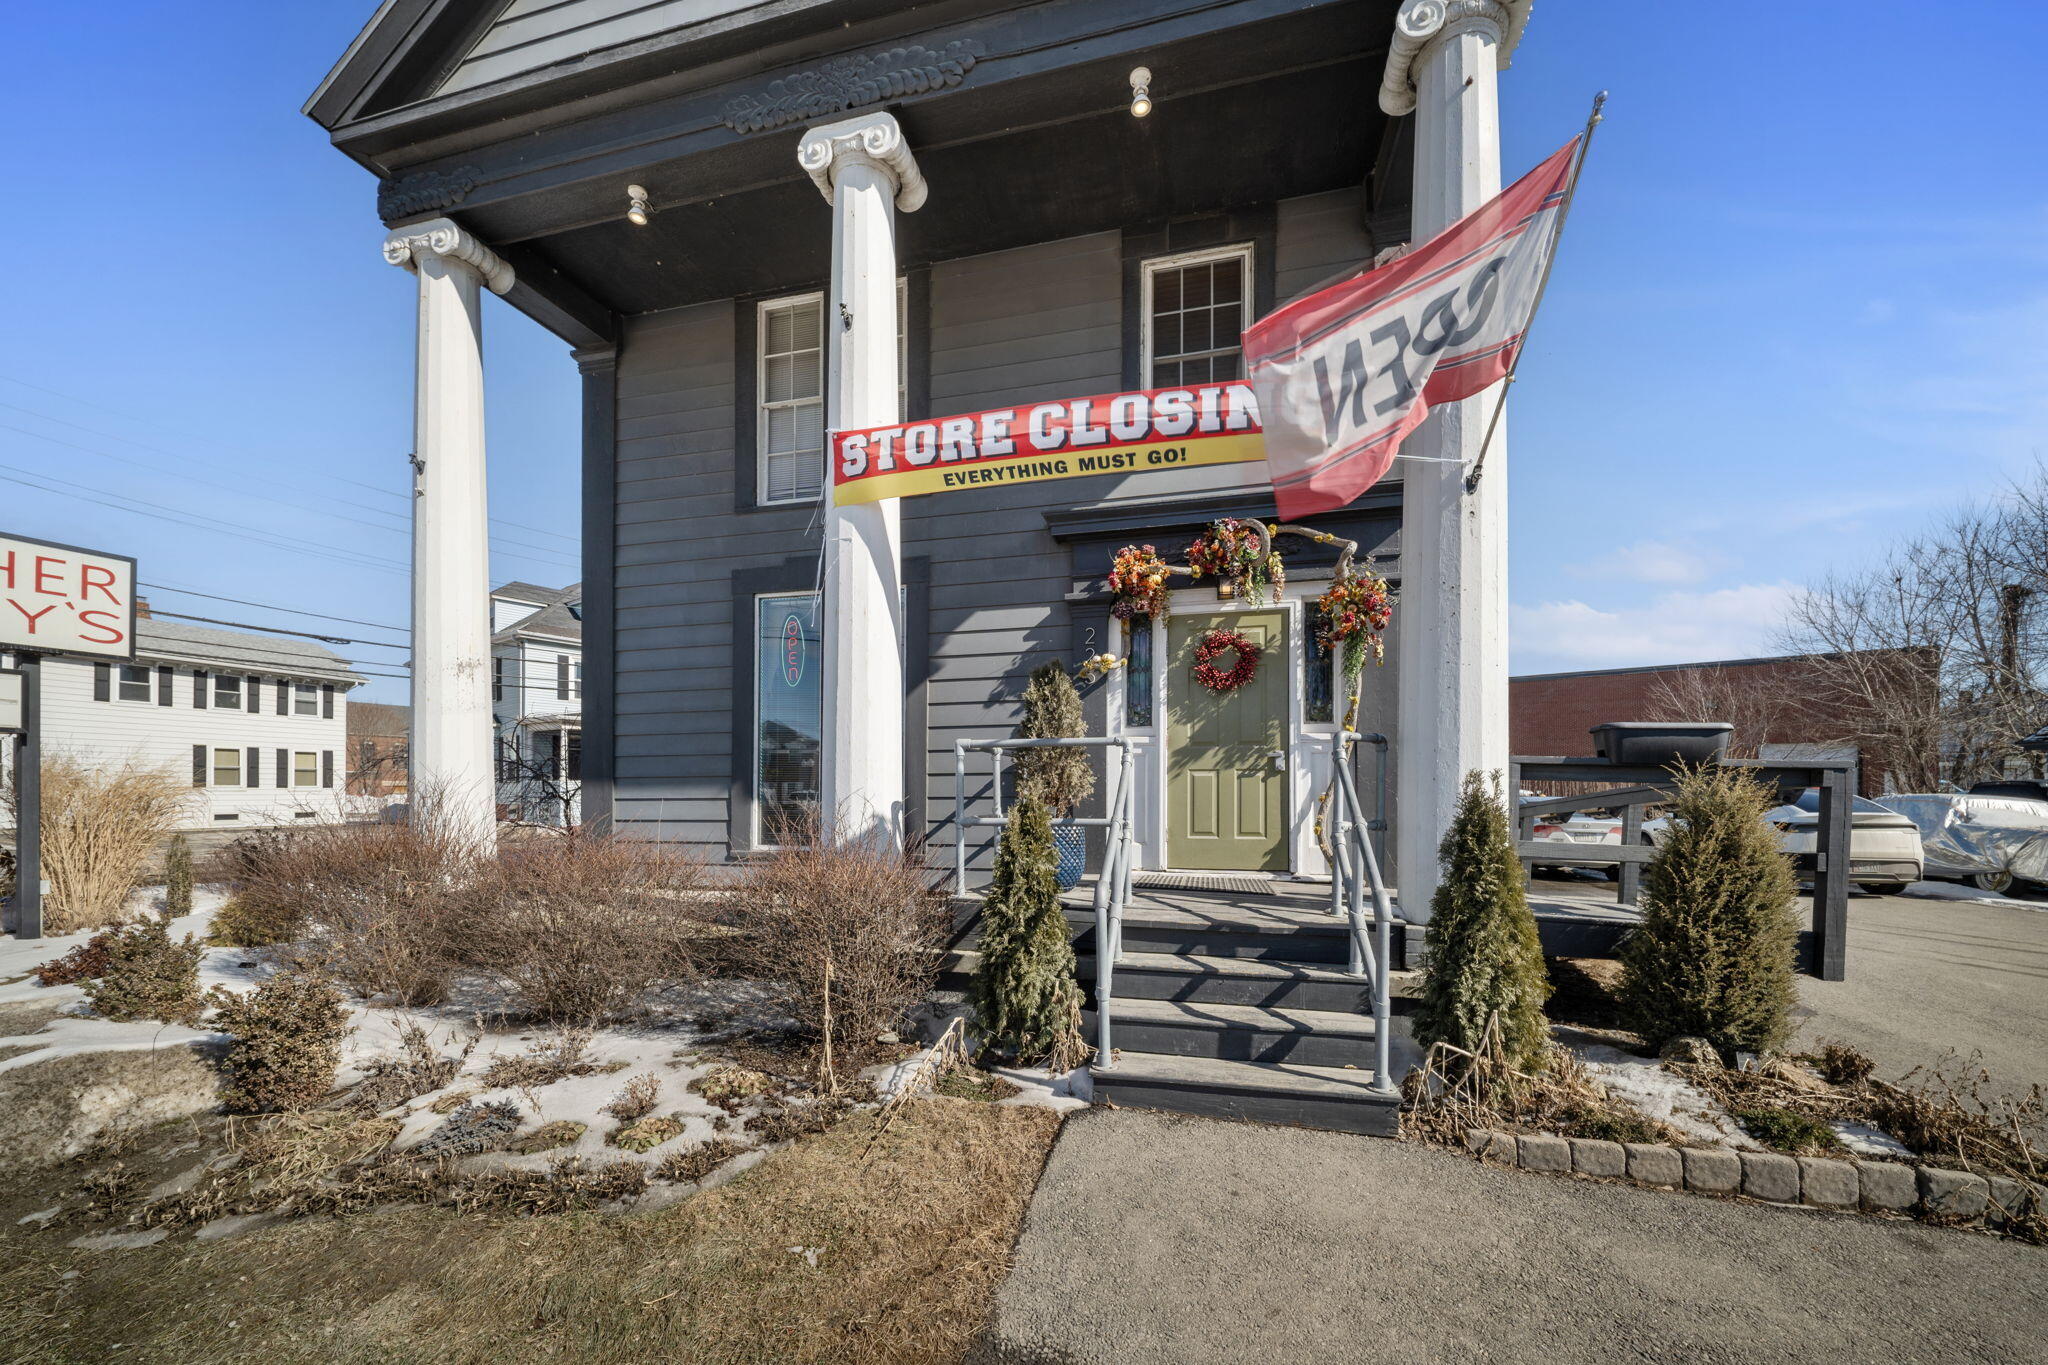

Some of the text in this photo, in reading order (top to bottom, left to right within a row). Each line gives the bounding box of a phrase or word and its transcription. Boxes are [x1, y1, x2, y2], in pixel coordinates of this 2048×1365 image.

[841, 384, 1263, 478] STORE CLOSIN
[943, 447, 1187, 487] EVERYTHING MUST GO!
